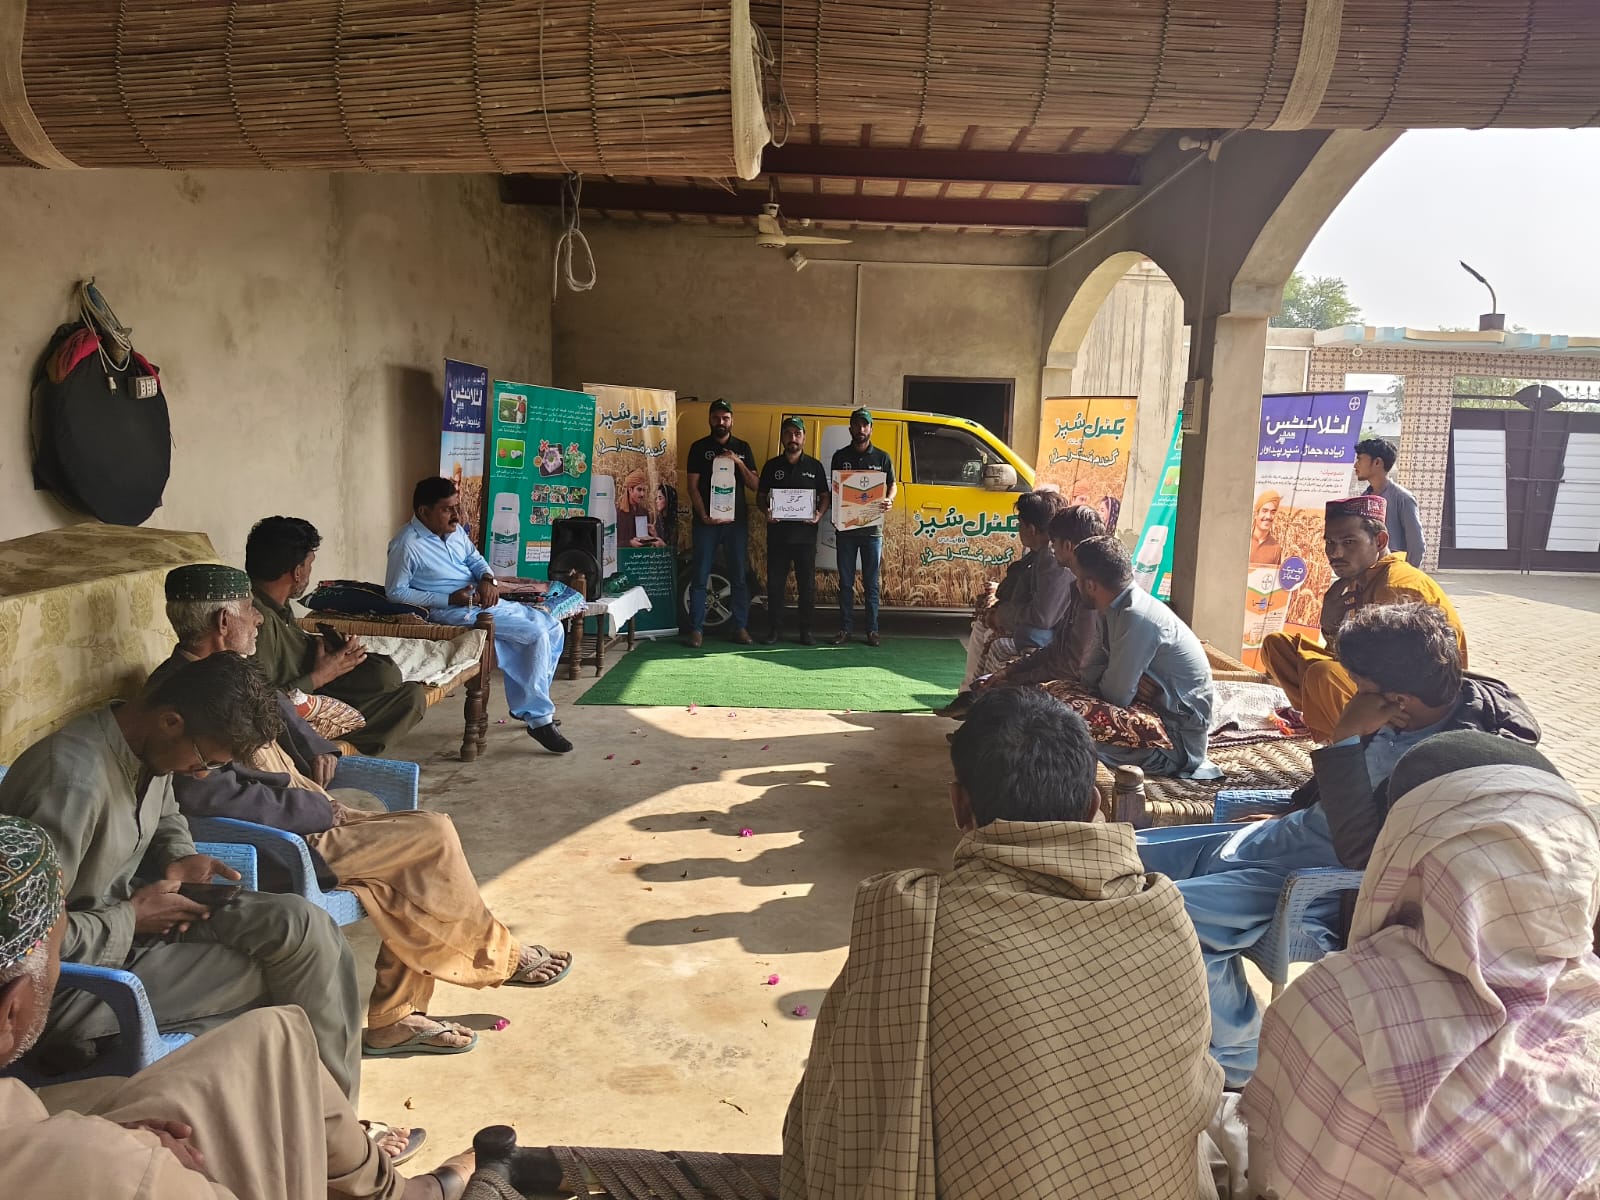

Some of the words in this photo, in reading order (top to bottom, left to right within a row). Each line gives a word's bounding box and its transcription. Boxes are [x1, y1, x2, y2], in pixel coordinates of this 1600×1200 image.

[644, 439, 667, 458] گندم
[1092, 448, 1120, 468] گندم
[1259, 446, 1282, 458] پیداوار
[1324, 446, 1345, 458] زیادہ
[983, 546, 1014, 567] گندم
